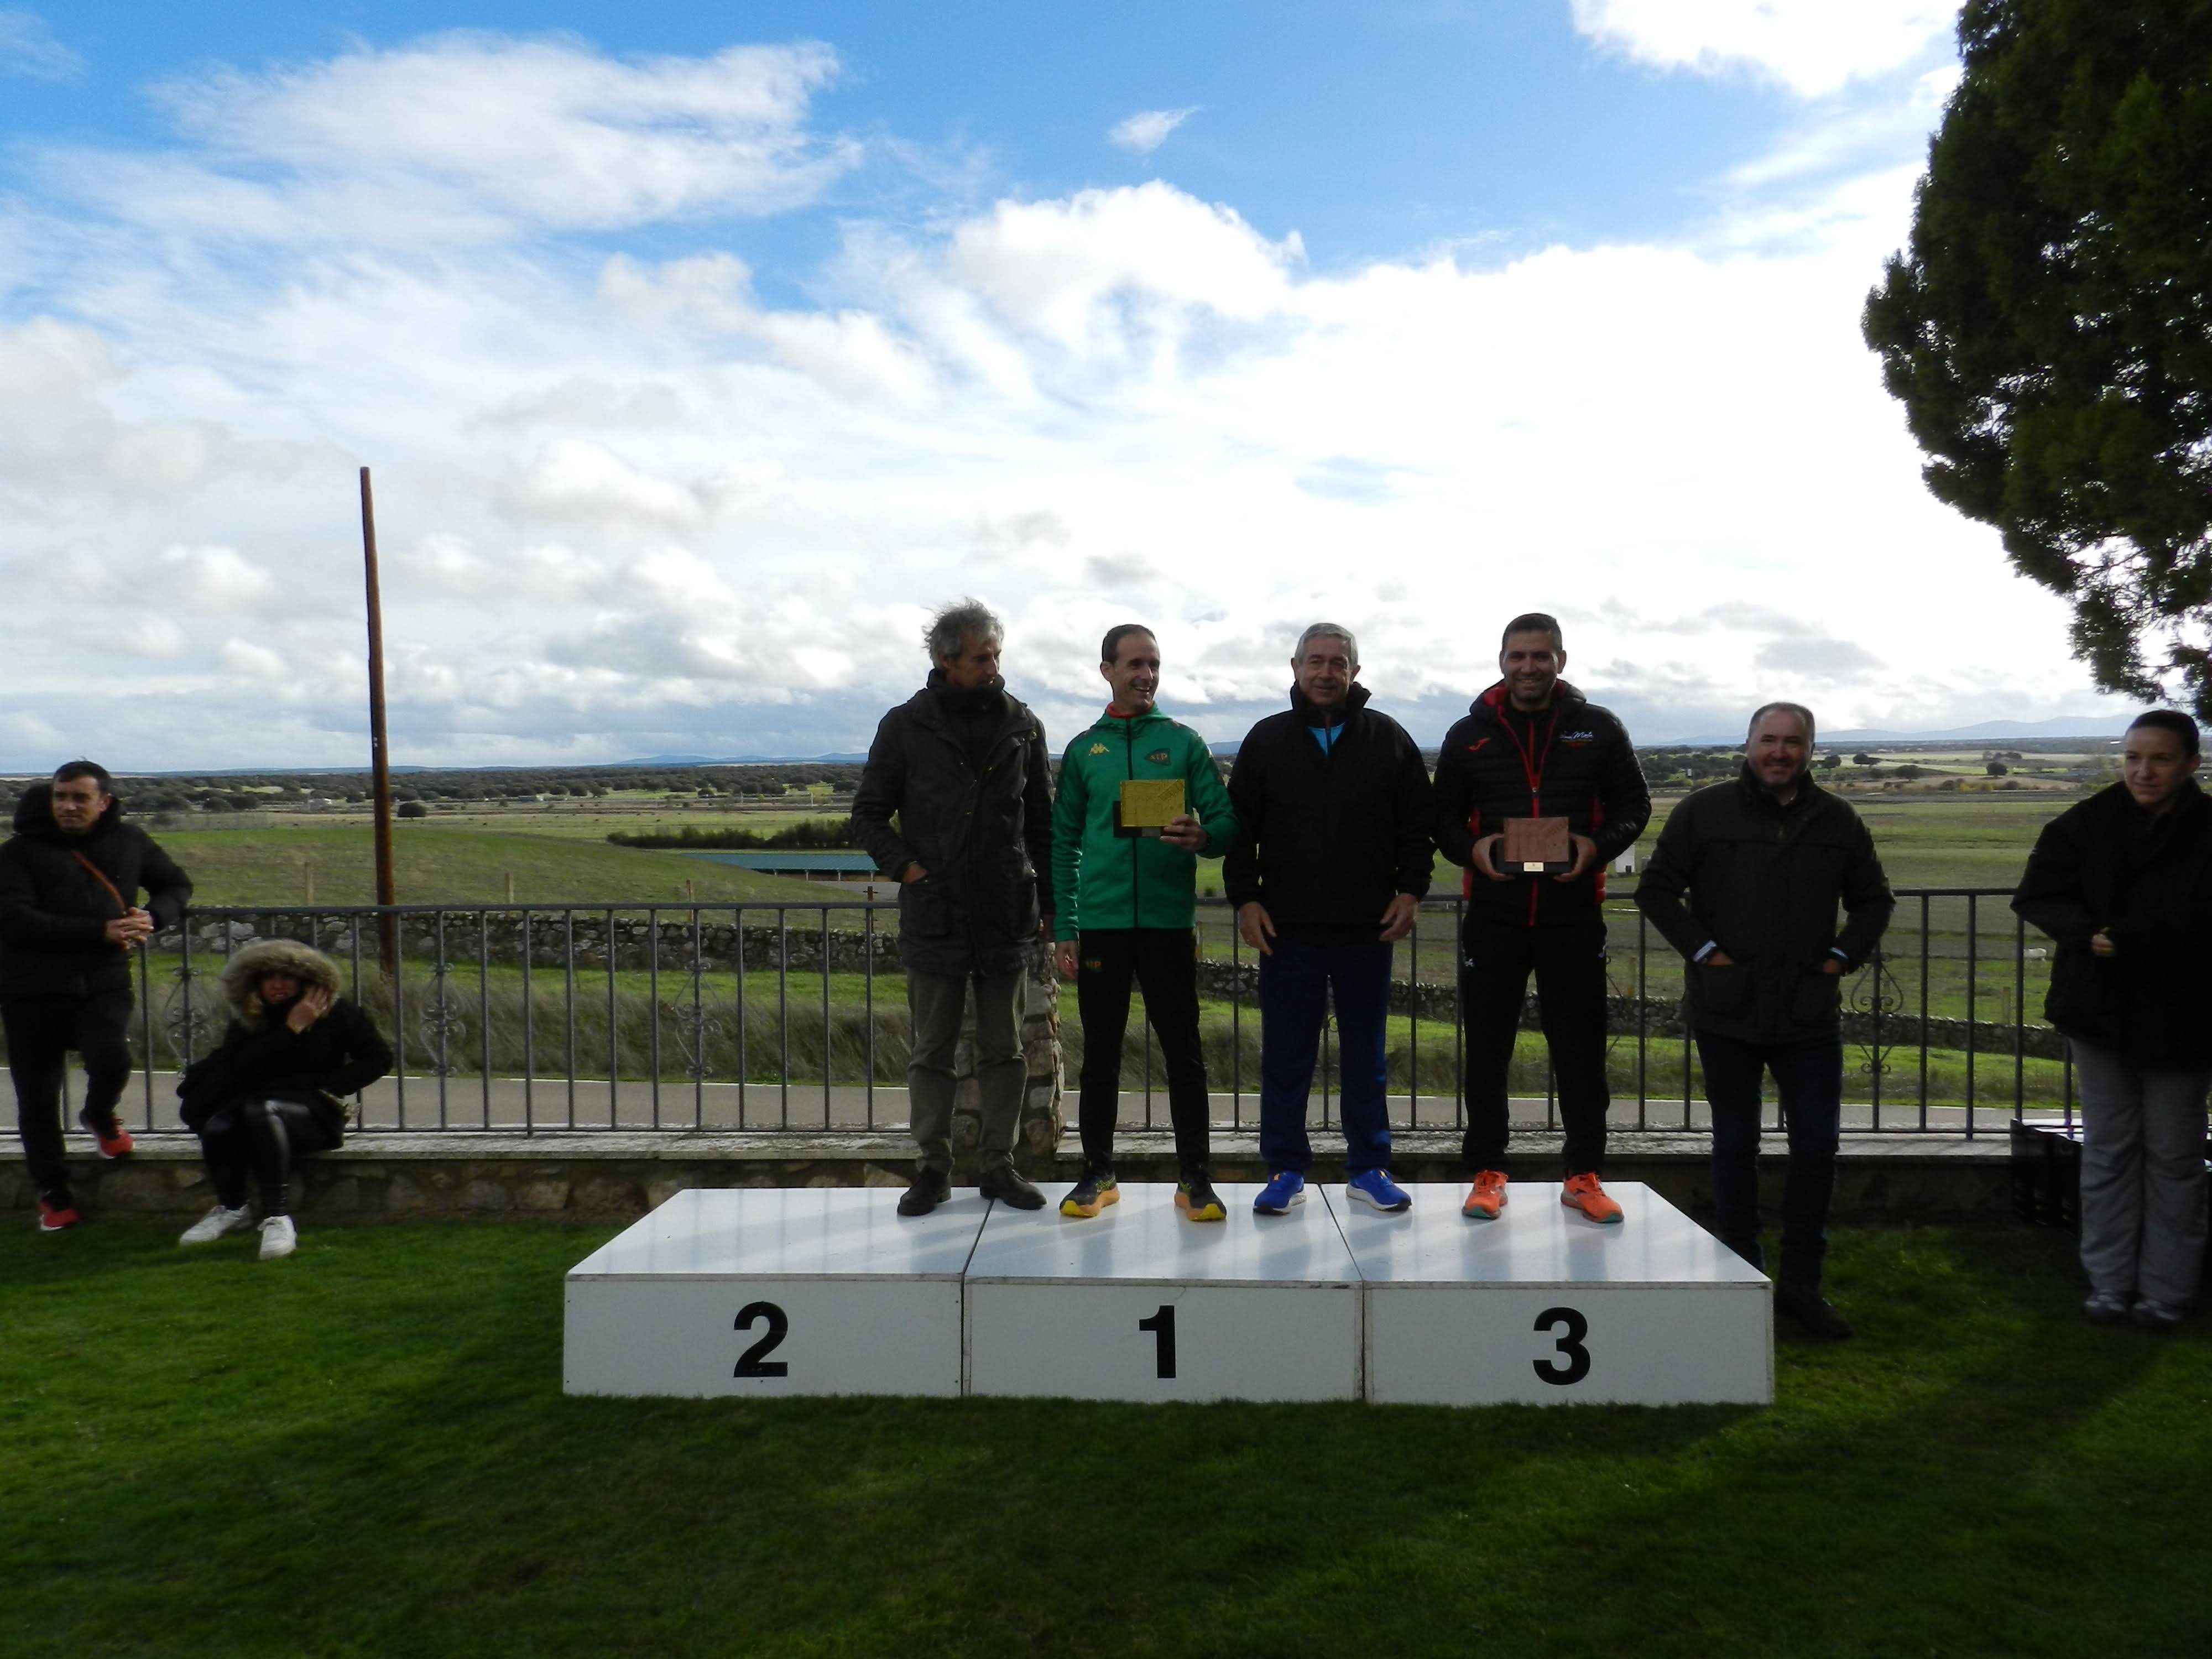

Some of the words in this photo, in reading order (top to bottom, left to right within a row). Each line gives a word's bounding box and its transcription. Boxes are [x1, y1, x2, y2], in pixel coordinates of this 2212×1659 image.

[734, 1301, 787, 1378] 2
[1139, 1305, 1176, 1378] 1
[1533, 1307, 1590, 1385] 3
